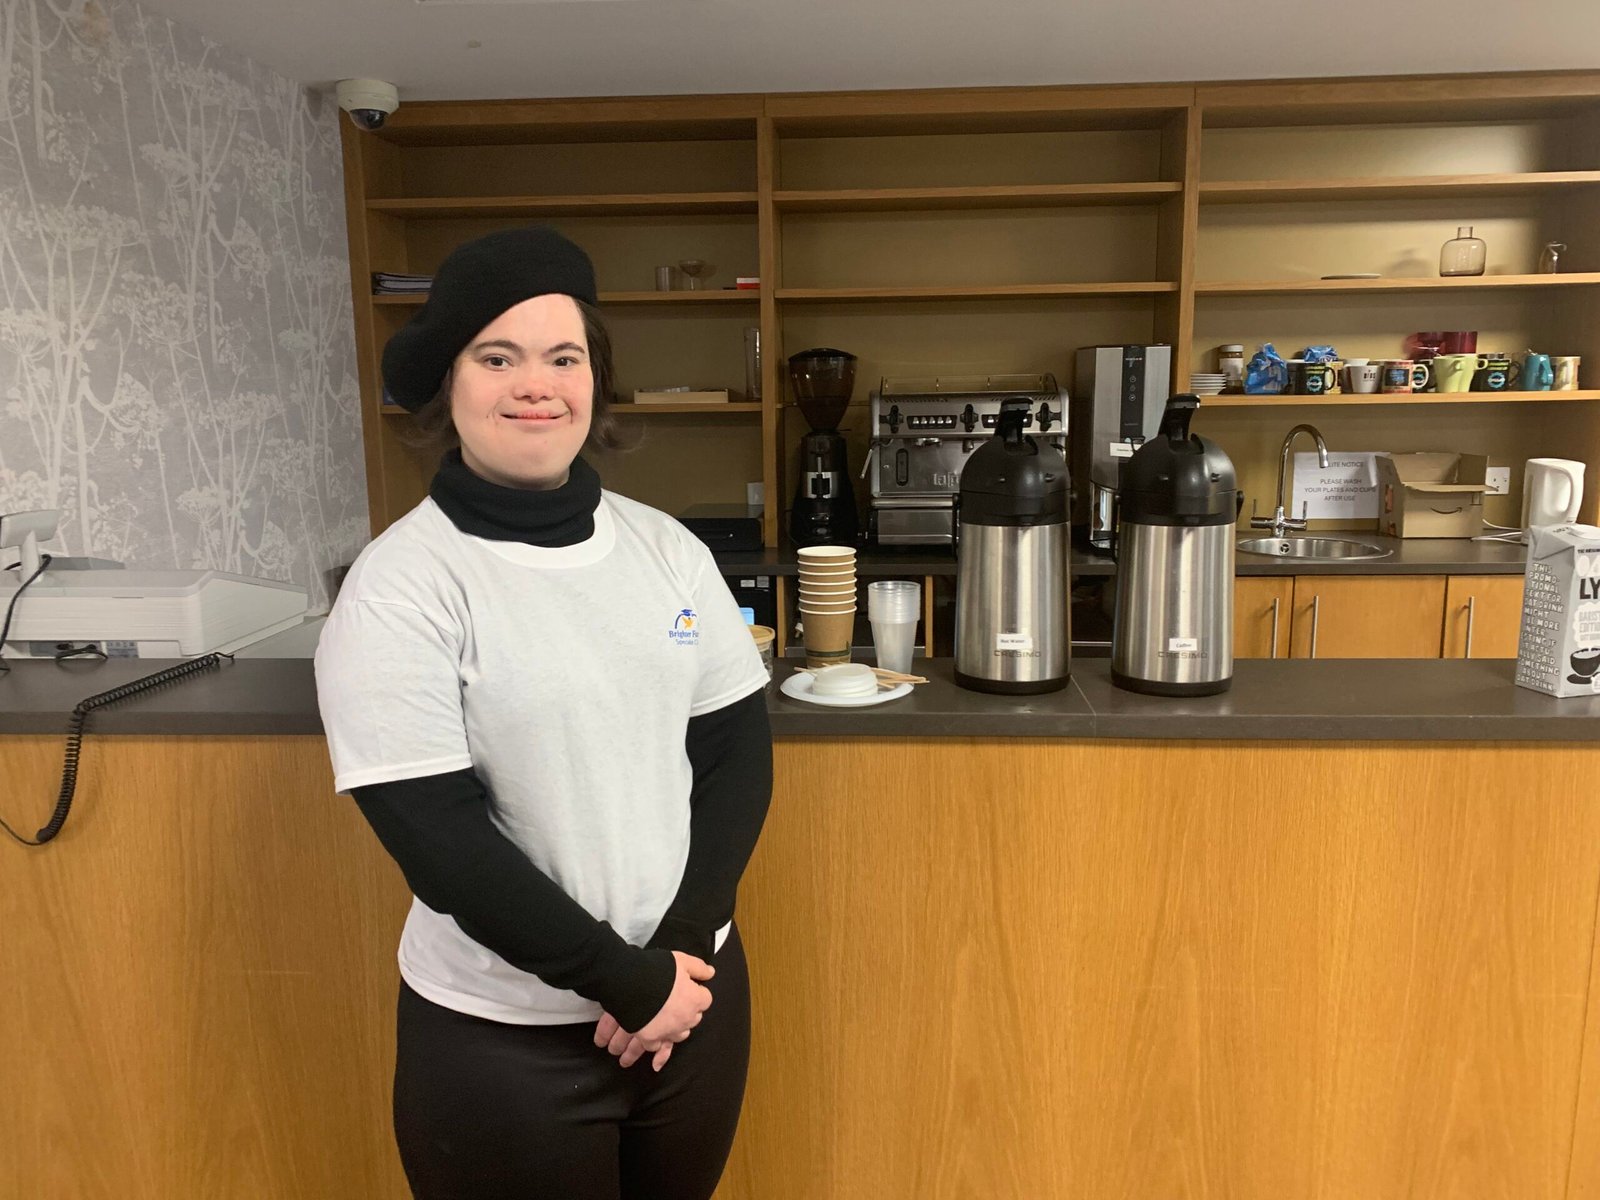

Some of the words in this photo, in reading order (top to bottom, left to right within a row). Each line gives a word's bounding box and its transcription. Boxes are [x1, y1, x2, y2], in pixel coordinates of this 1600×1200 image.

[1533, 563, 1552, 573] THIS
[1531, 581, 1558, 593] TIONAL
[1547, 593, 1561, 602] FOR
[1539, 601, 1563, 612] DRINK
[1525, 607, 1549, 618] MIGHT
[1537, 619, 1559, 630] MORE
[994, 650, 1041, 658] CRESIMO
